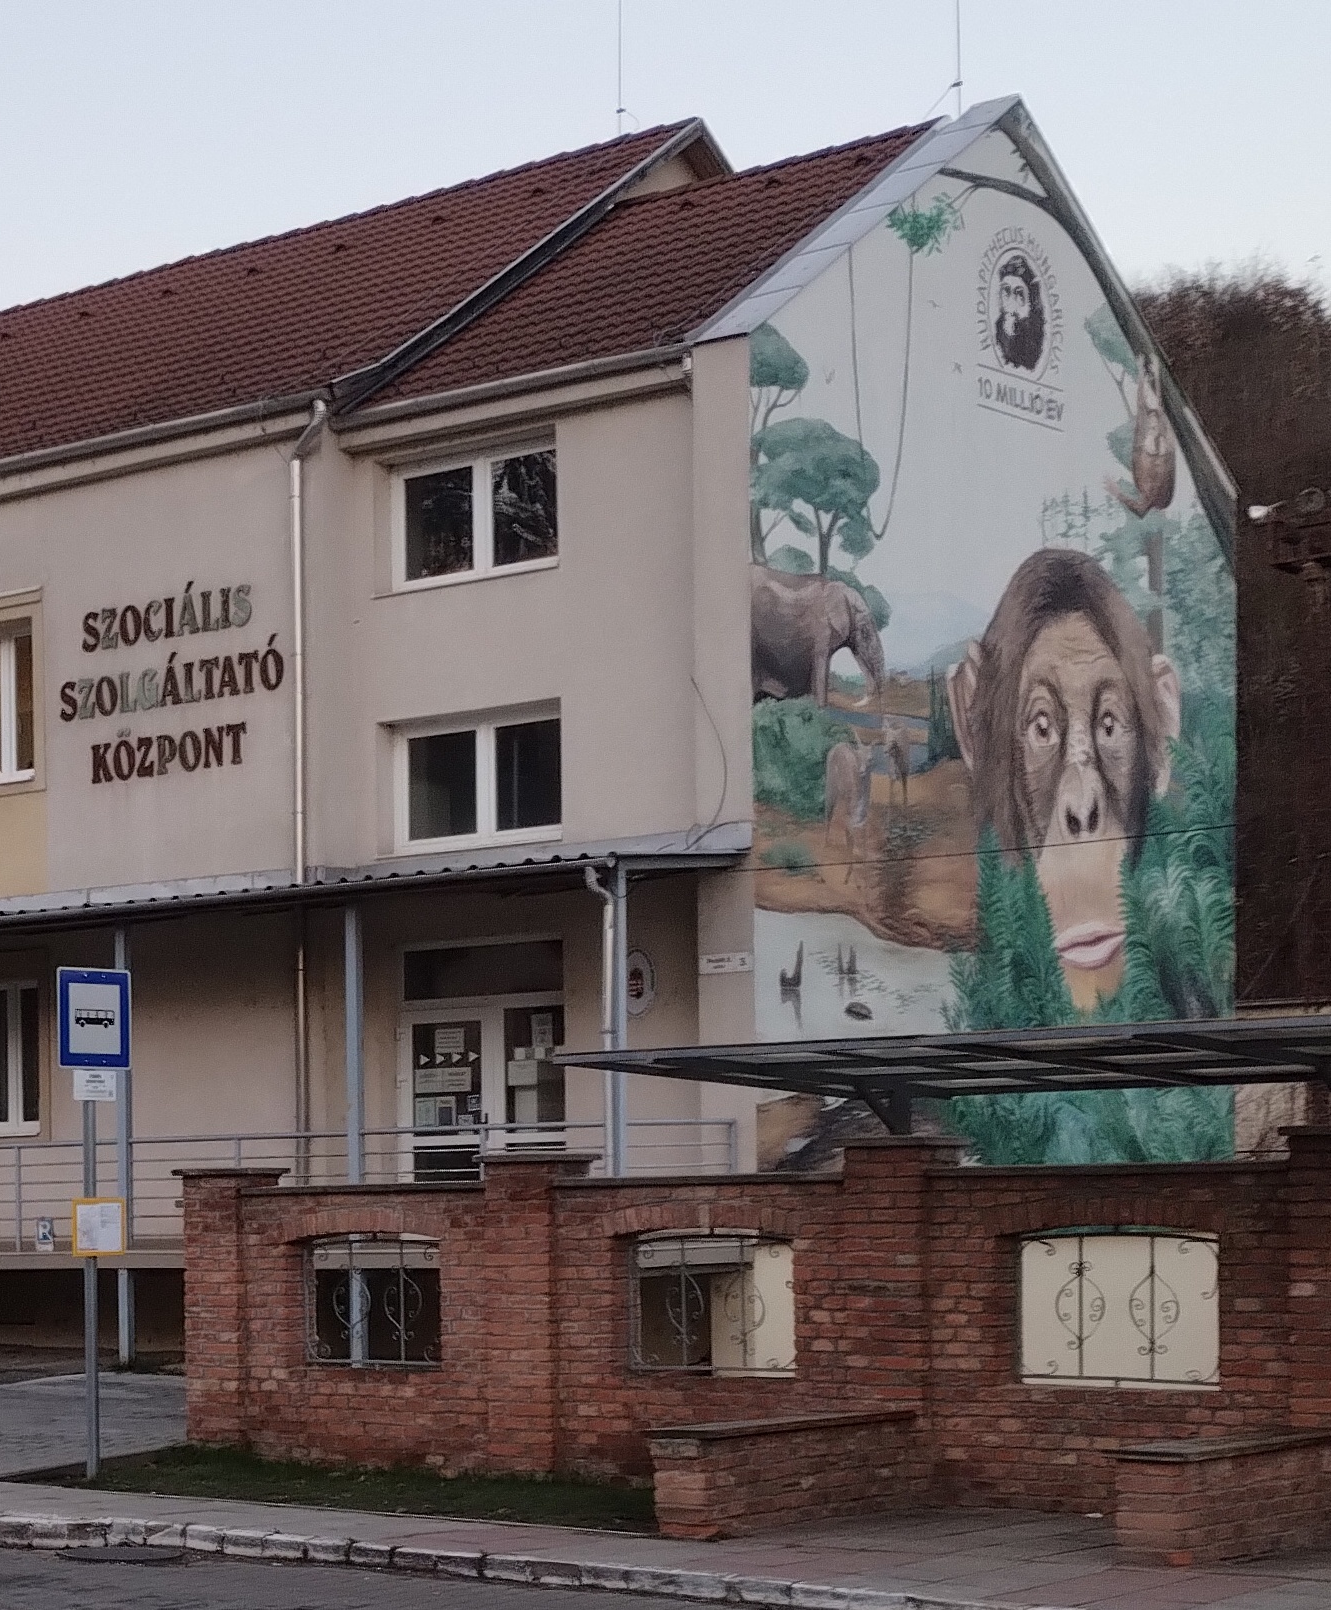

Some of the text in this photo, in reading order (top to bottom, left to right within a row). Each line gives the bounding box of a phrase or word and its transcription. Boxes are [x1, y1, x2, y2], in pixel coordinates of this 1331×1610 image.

[977, 376, 993, 400] 10
[81, 580, 252, 653] SZOCIÁLIS
[59, 632, 284, 722] SZOLGÁLTATÓ
[90, 721, 247, 785] KÖZPONT
